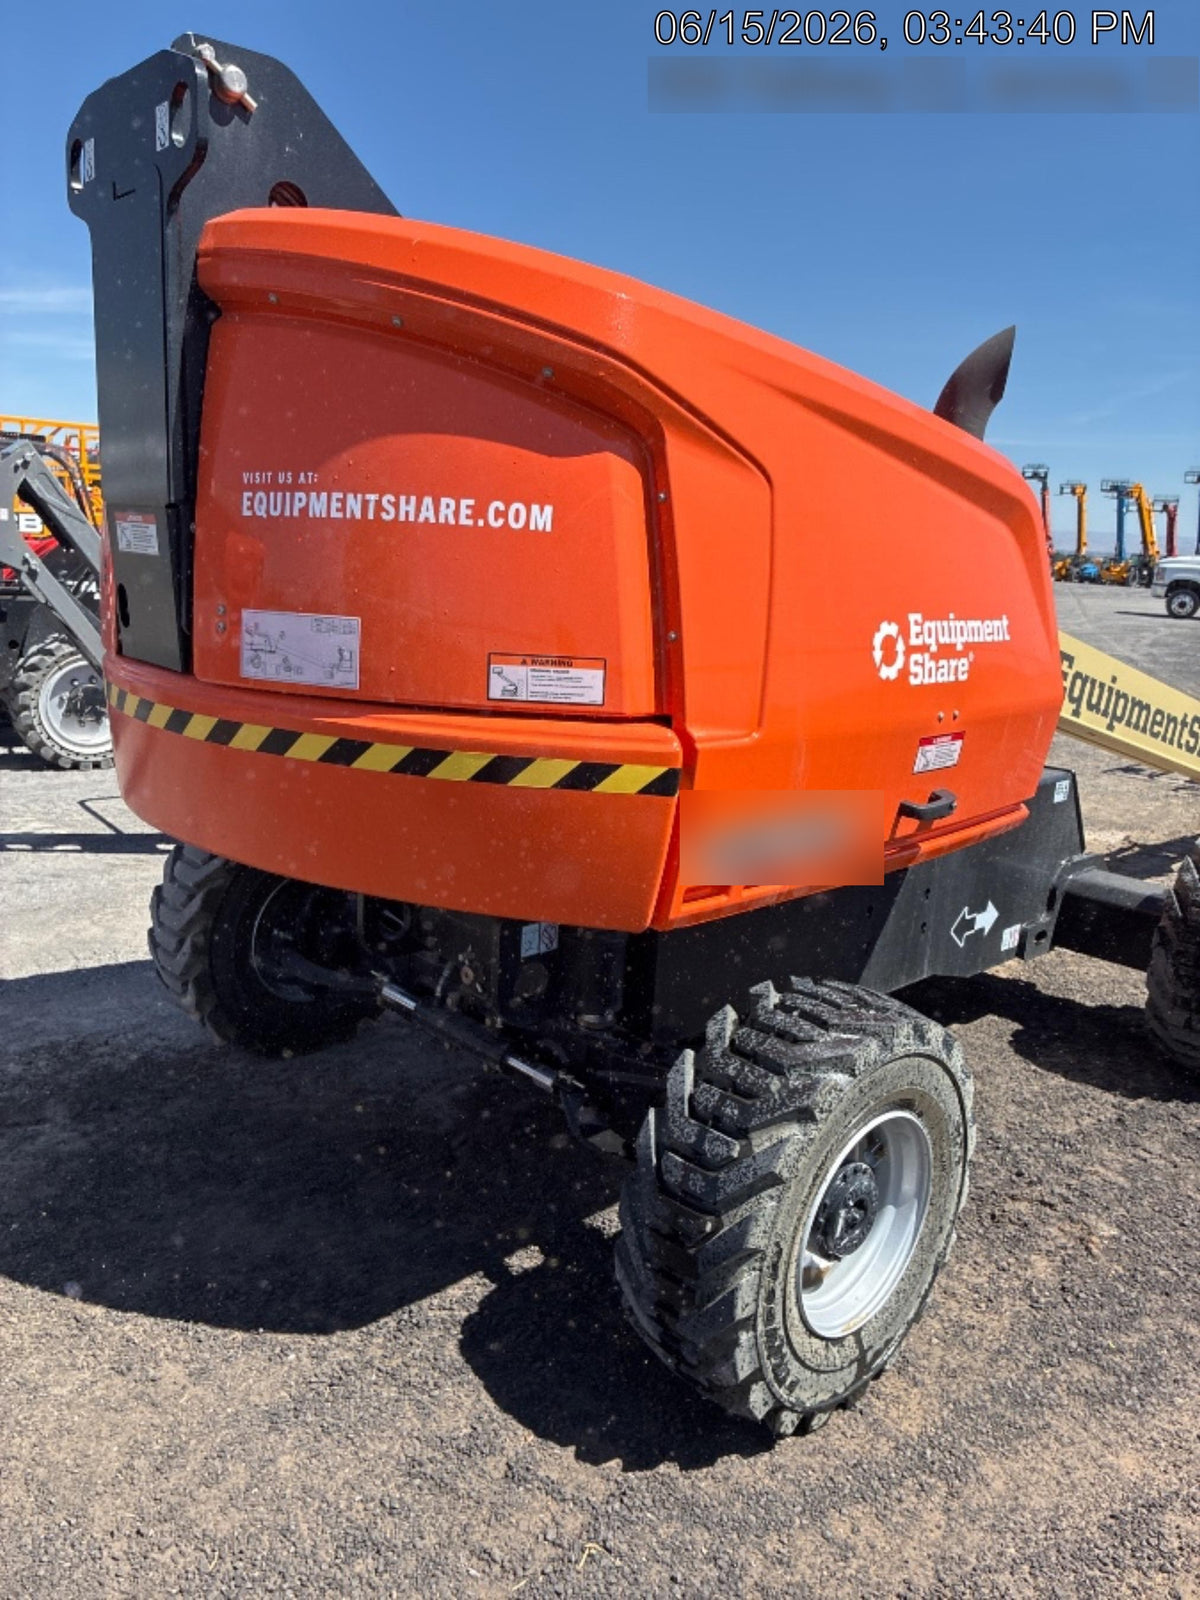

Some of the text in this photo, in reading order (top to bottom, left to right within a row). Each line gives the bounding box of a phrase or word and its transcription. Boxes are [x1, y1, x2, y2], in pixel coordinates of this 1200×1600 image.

[242, 472, 318, 484] VISIT US AT:
[242, 491, 554, 533] EQUIPMENTSHARE.COM
[907, 612, 1011, 652] Equipment
[530, 658, 574, 668] WARNING
